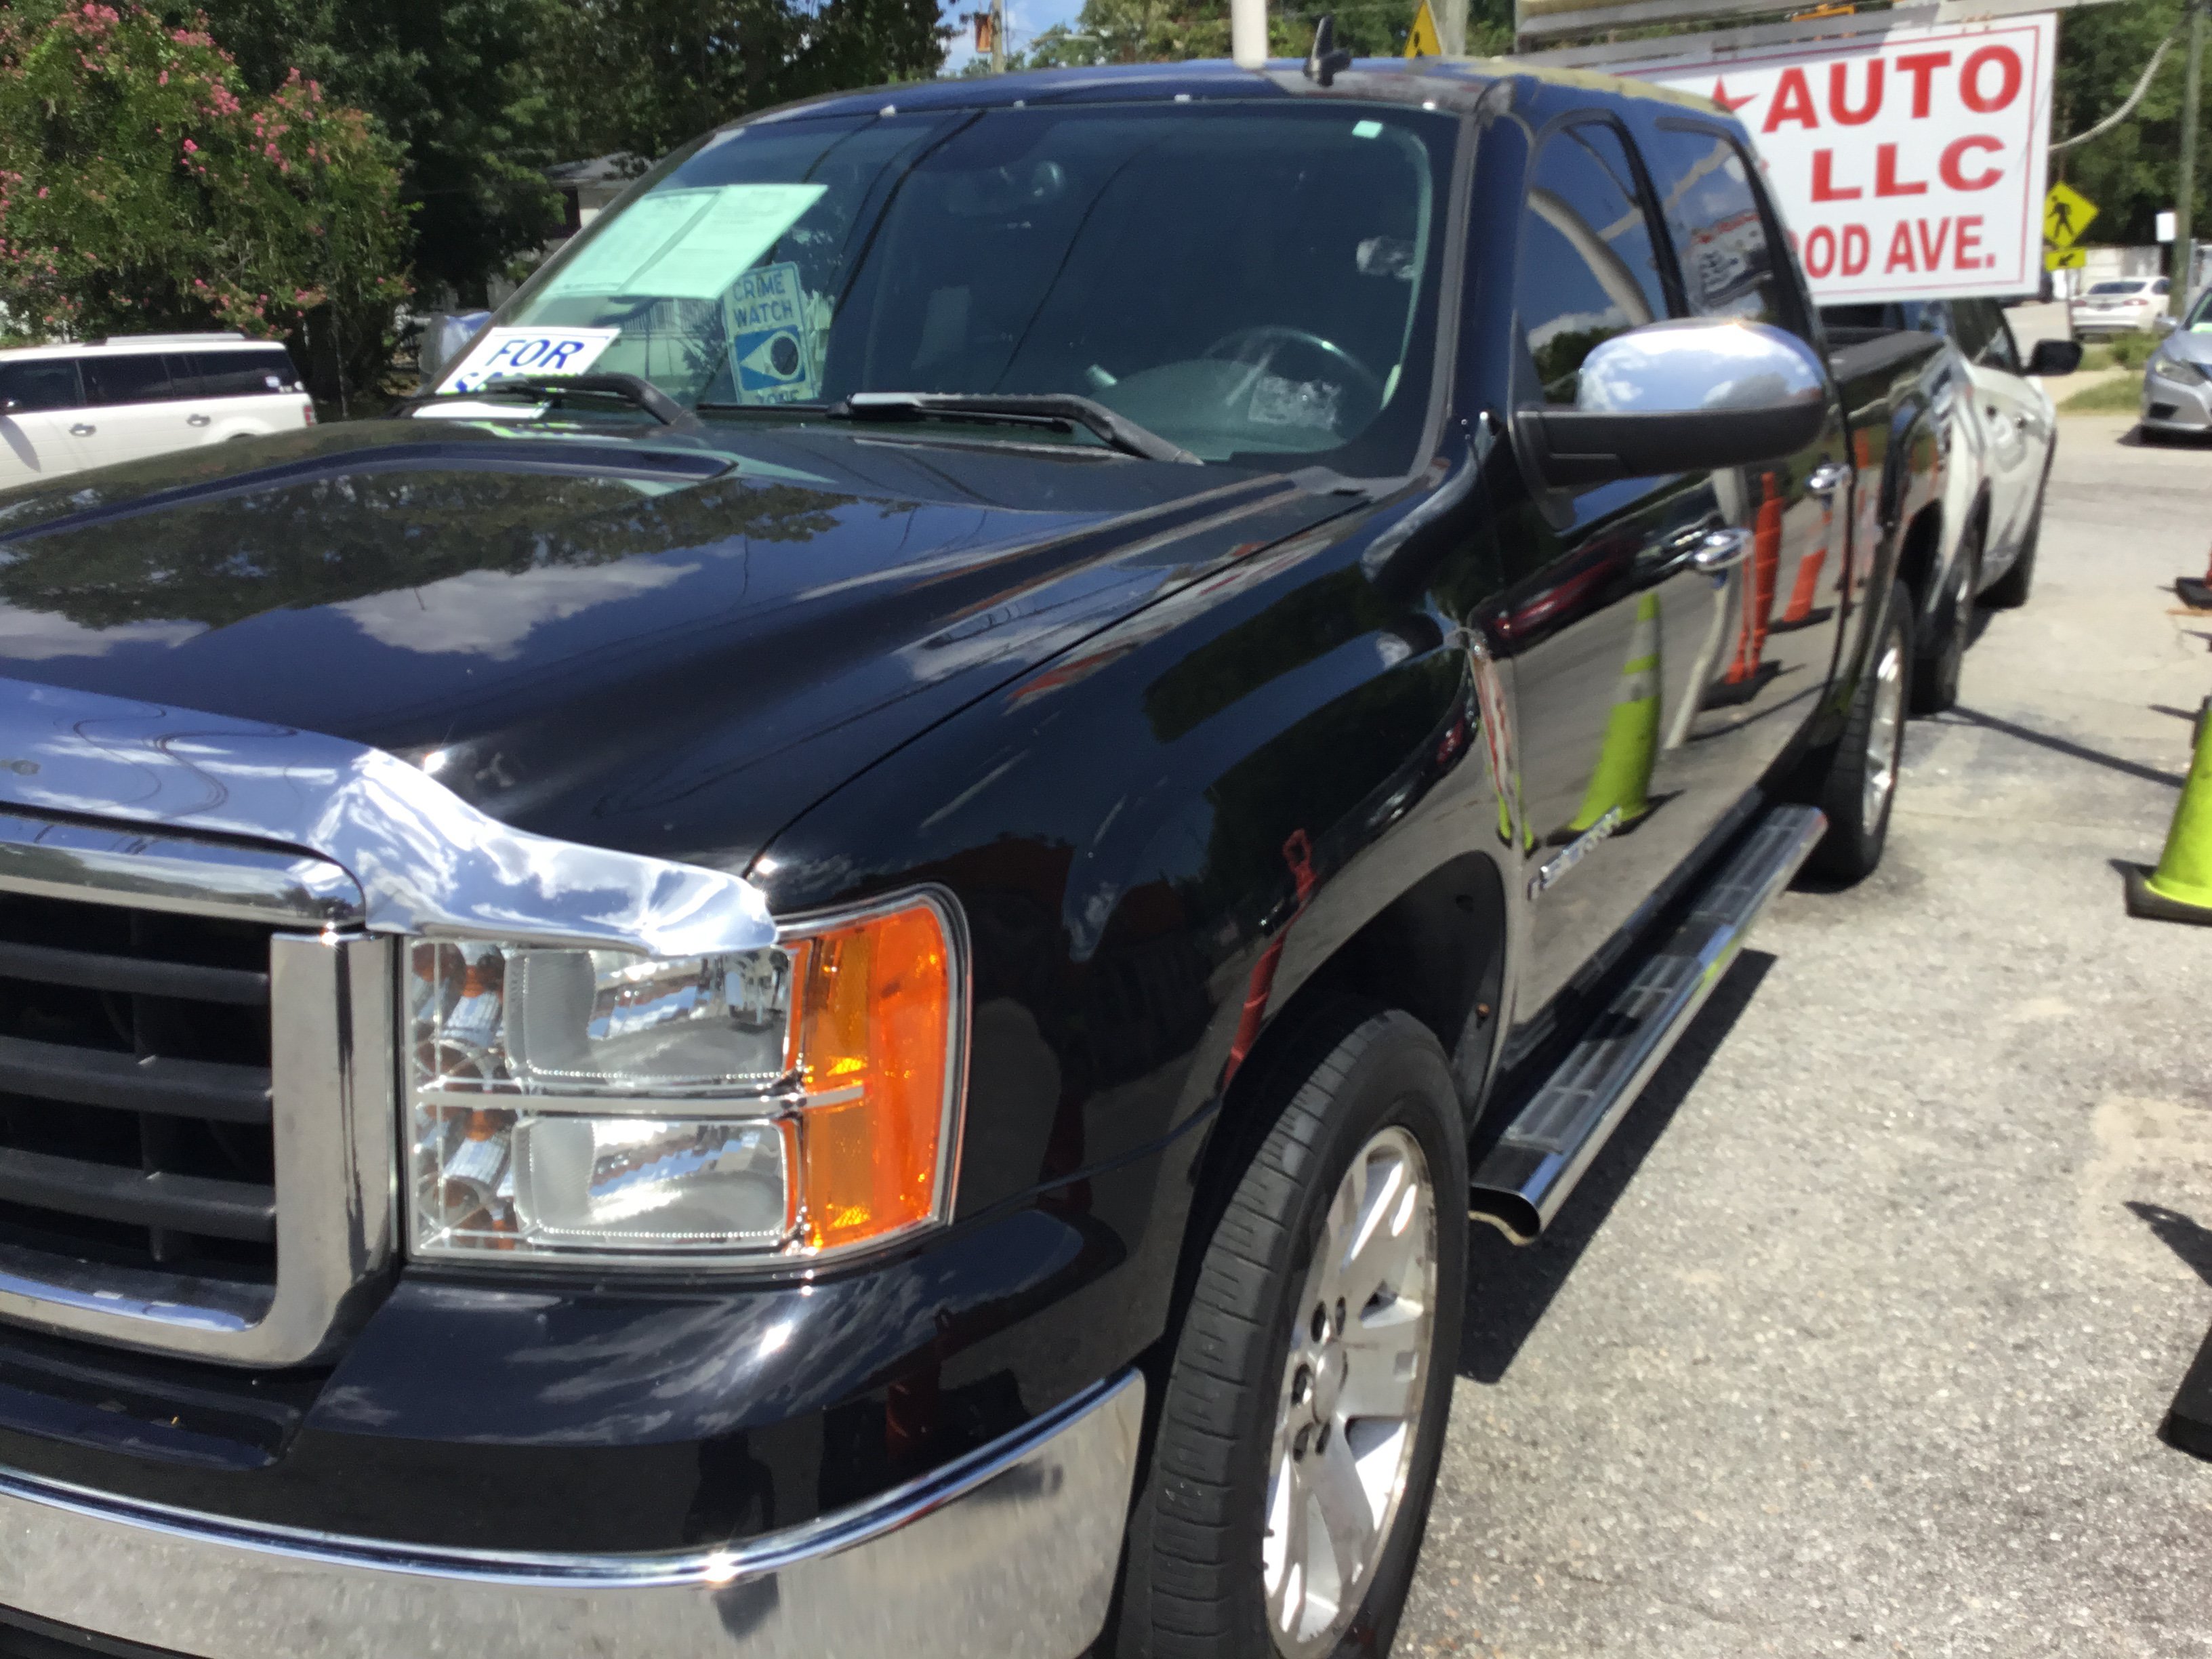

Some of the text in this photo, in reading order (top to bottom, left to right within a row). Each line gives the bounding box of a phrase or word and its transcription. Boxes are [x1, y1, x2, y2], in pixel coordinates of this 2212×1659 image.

[1761, 44, 2022, 133] AUTO
[1811, 134, 2005, 203] LLC
[1884, 214, 1996, 274] AVE.
[733, 272, 786, 302] CRIME
[734, 299, 793, 327] WATCH
[485, 339, 585, 369] FOR
